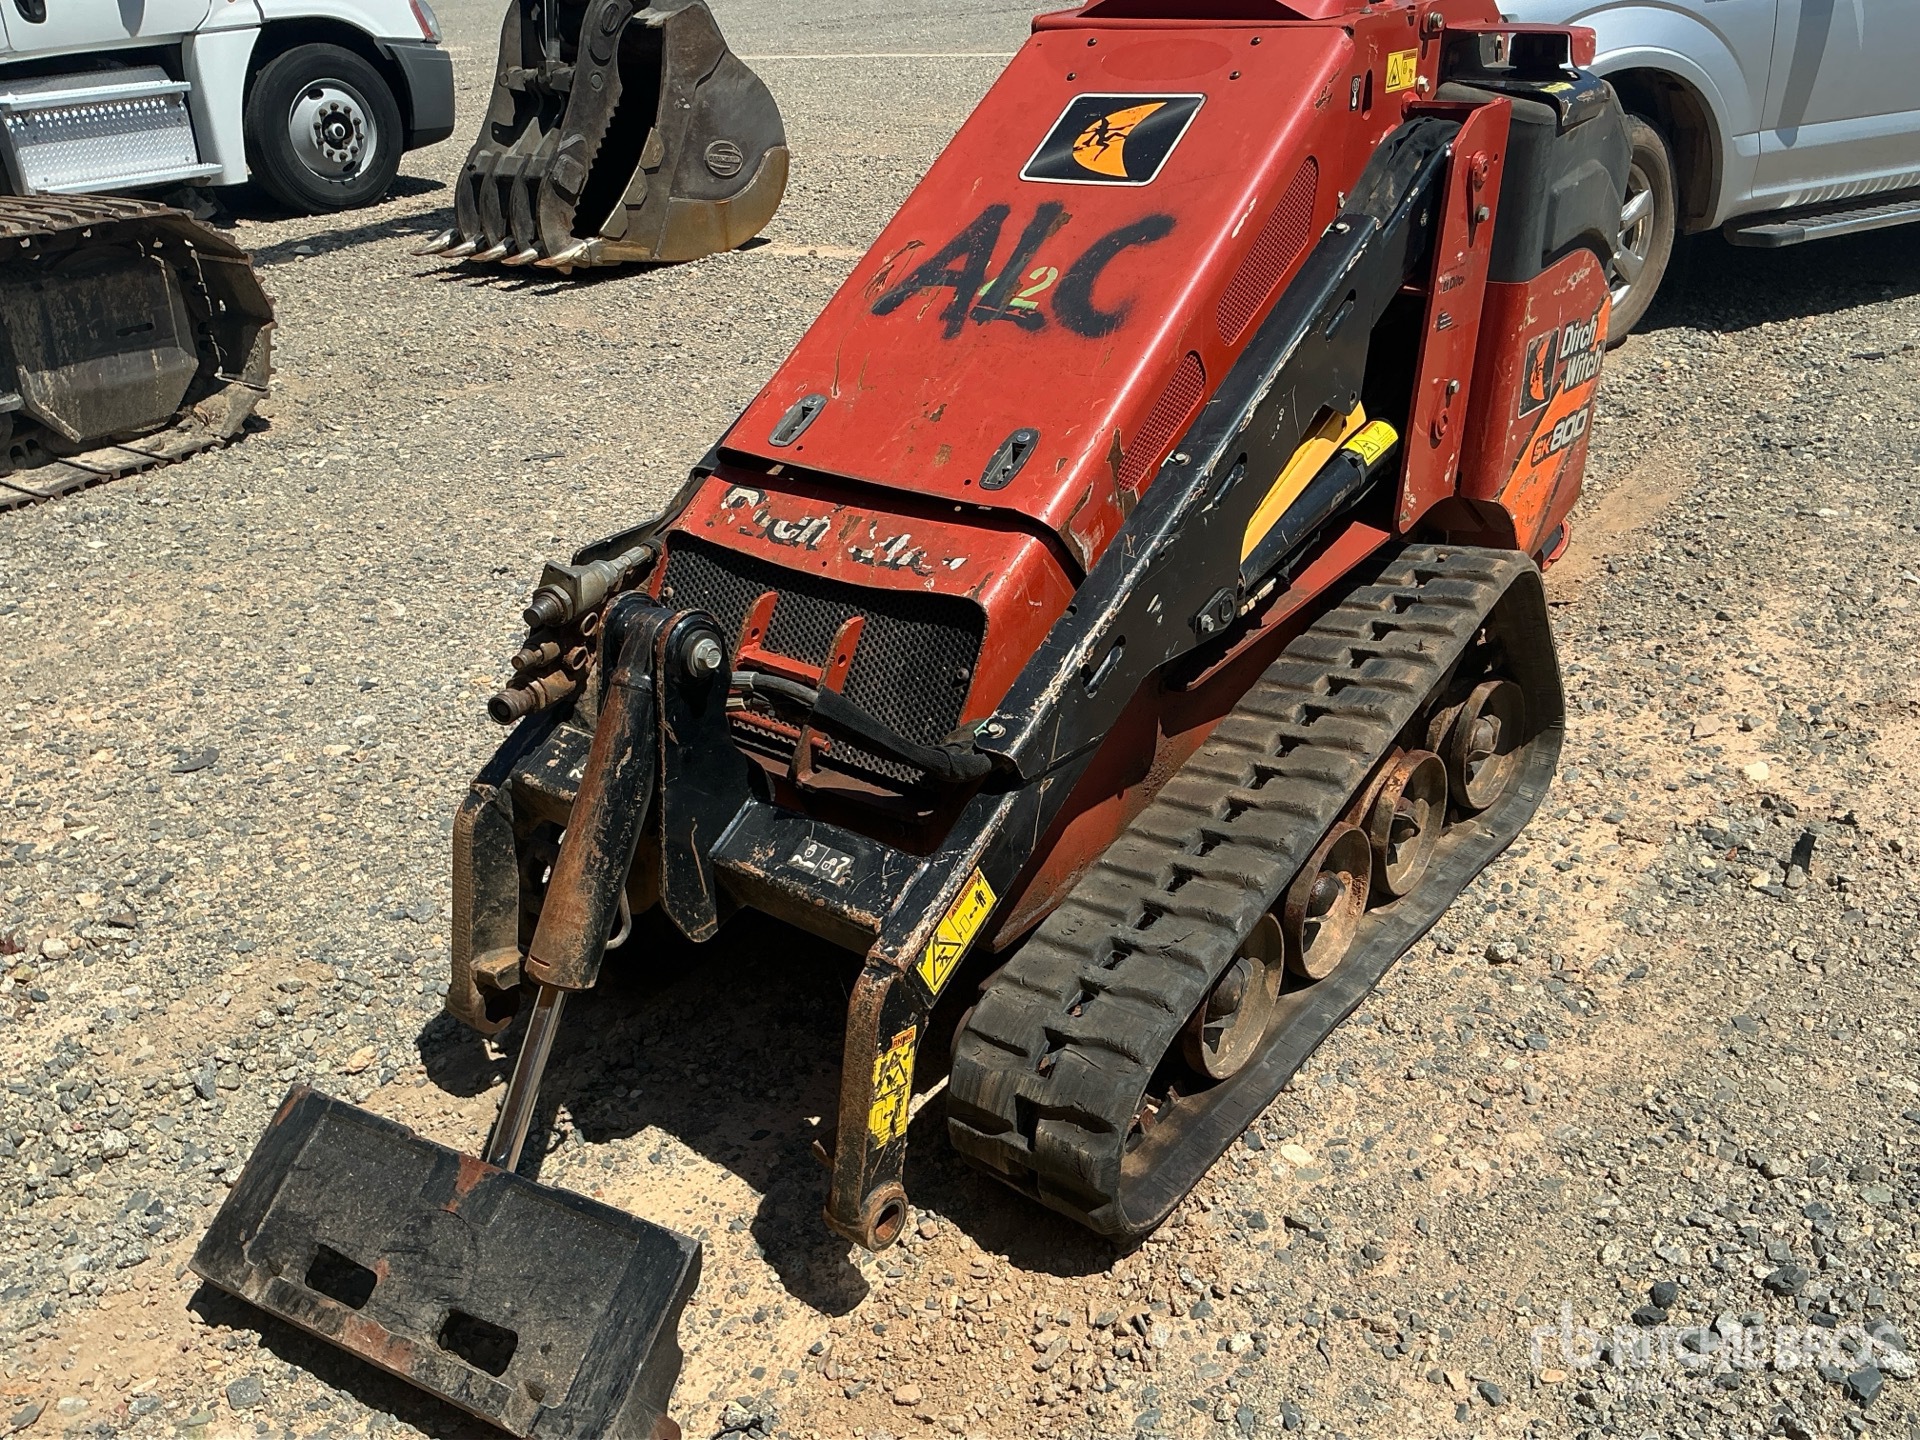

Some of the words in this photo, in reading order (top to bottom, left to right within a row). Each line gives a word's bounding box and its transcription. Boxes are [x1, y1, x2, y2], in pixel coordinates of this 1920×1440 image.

[870, 200, 1178, 341] ALC
[1559, 314, 1599, 360] Ditch
[1563, 343, 1603, 391] Witch
